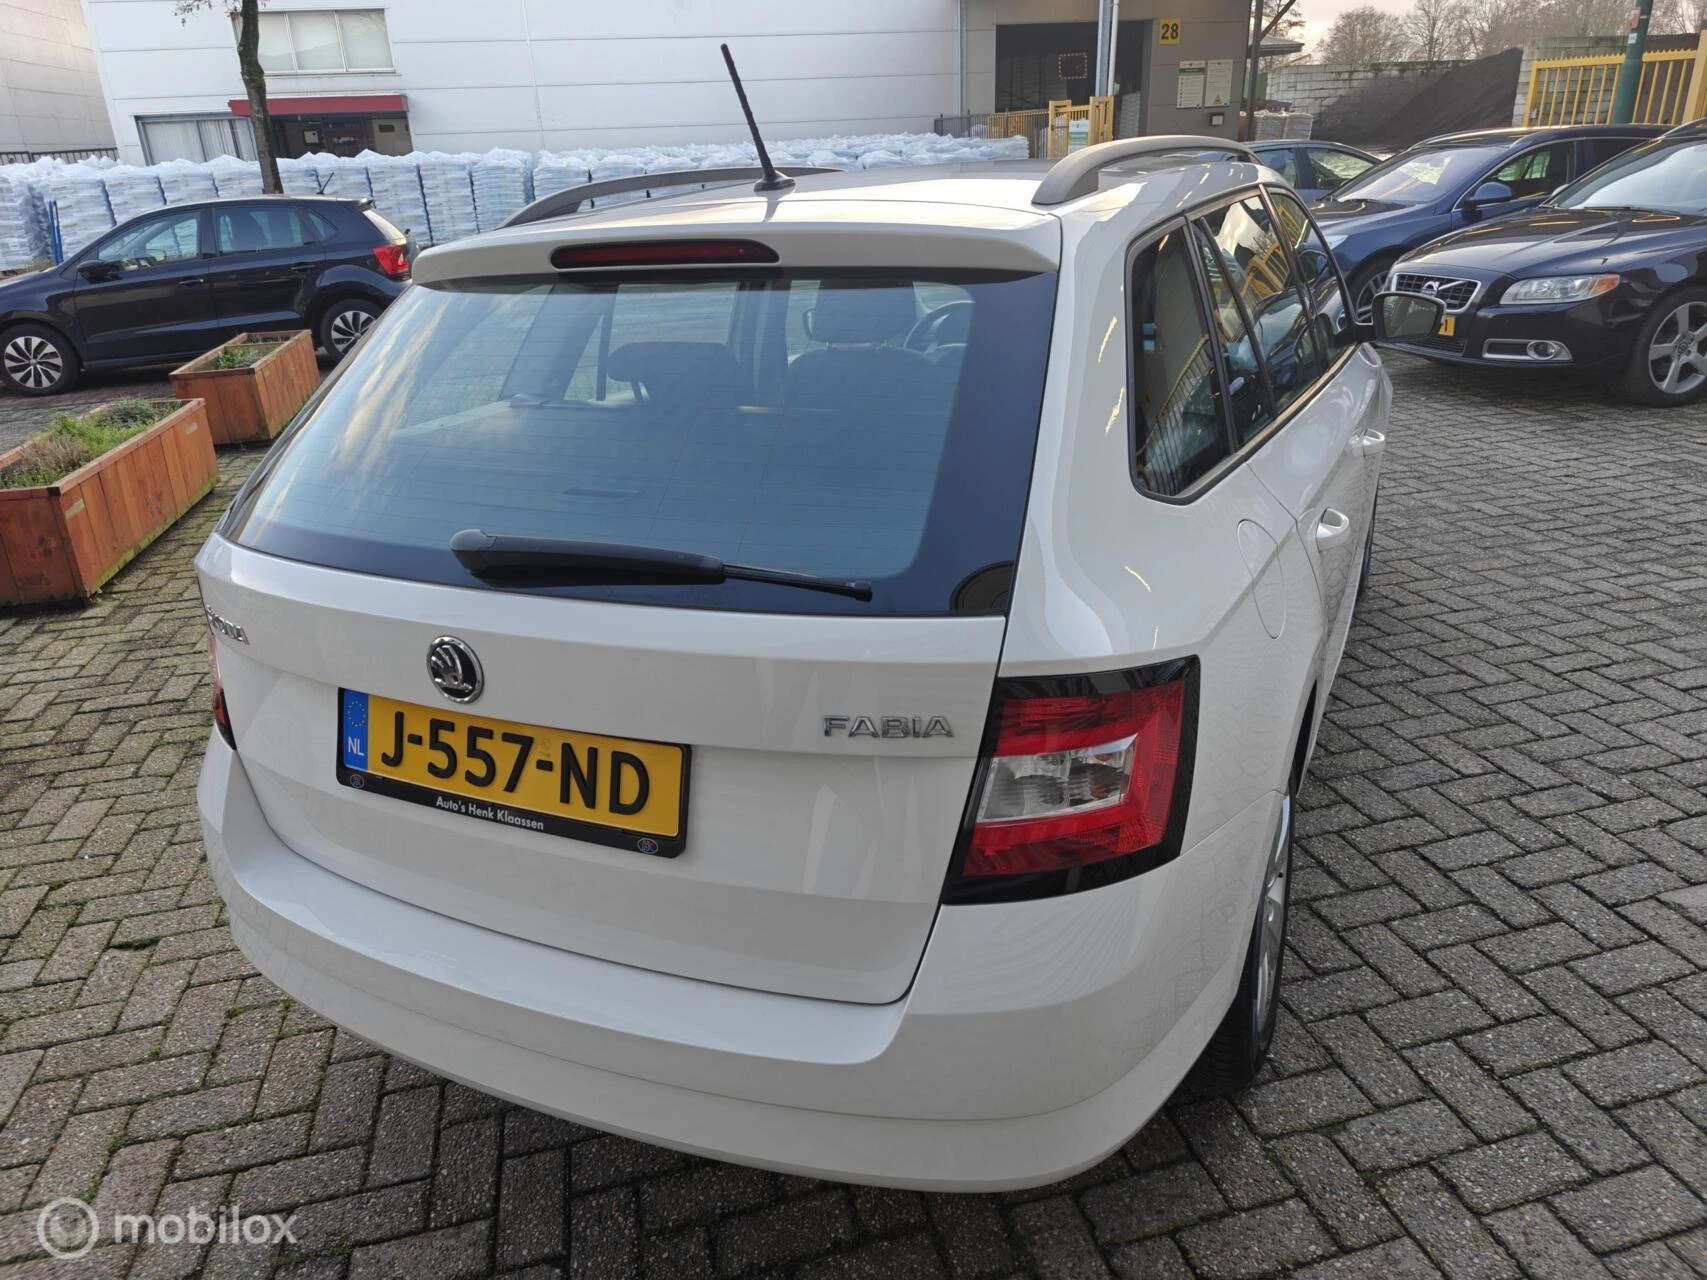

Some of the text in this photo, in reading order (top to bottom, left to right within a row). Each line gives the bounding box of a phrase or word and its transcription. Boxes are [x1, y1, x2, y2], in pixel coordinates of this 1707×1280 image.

[1161, 23, 1179, 40] 28
[824, 715, 955, 738] FABIA
[348, 736, 365, 757] NL
[381, 711, 650, 815] J-557-ND
[436, 796, 544, 831] Auto's Henk Klaassen
